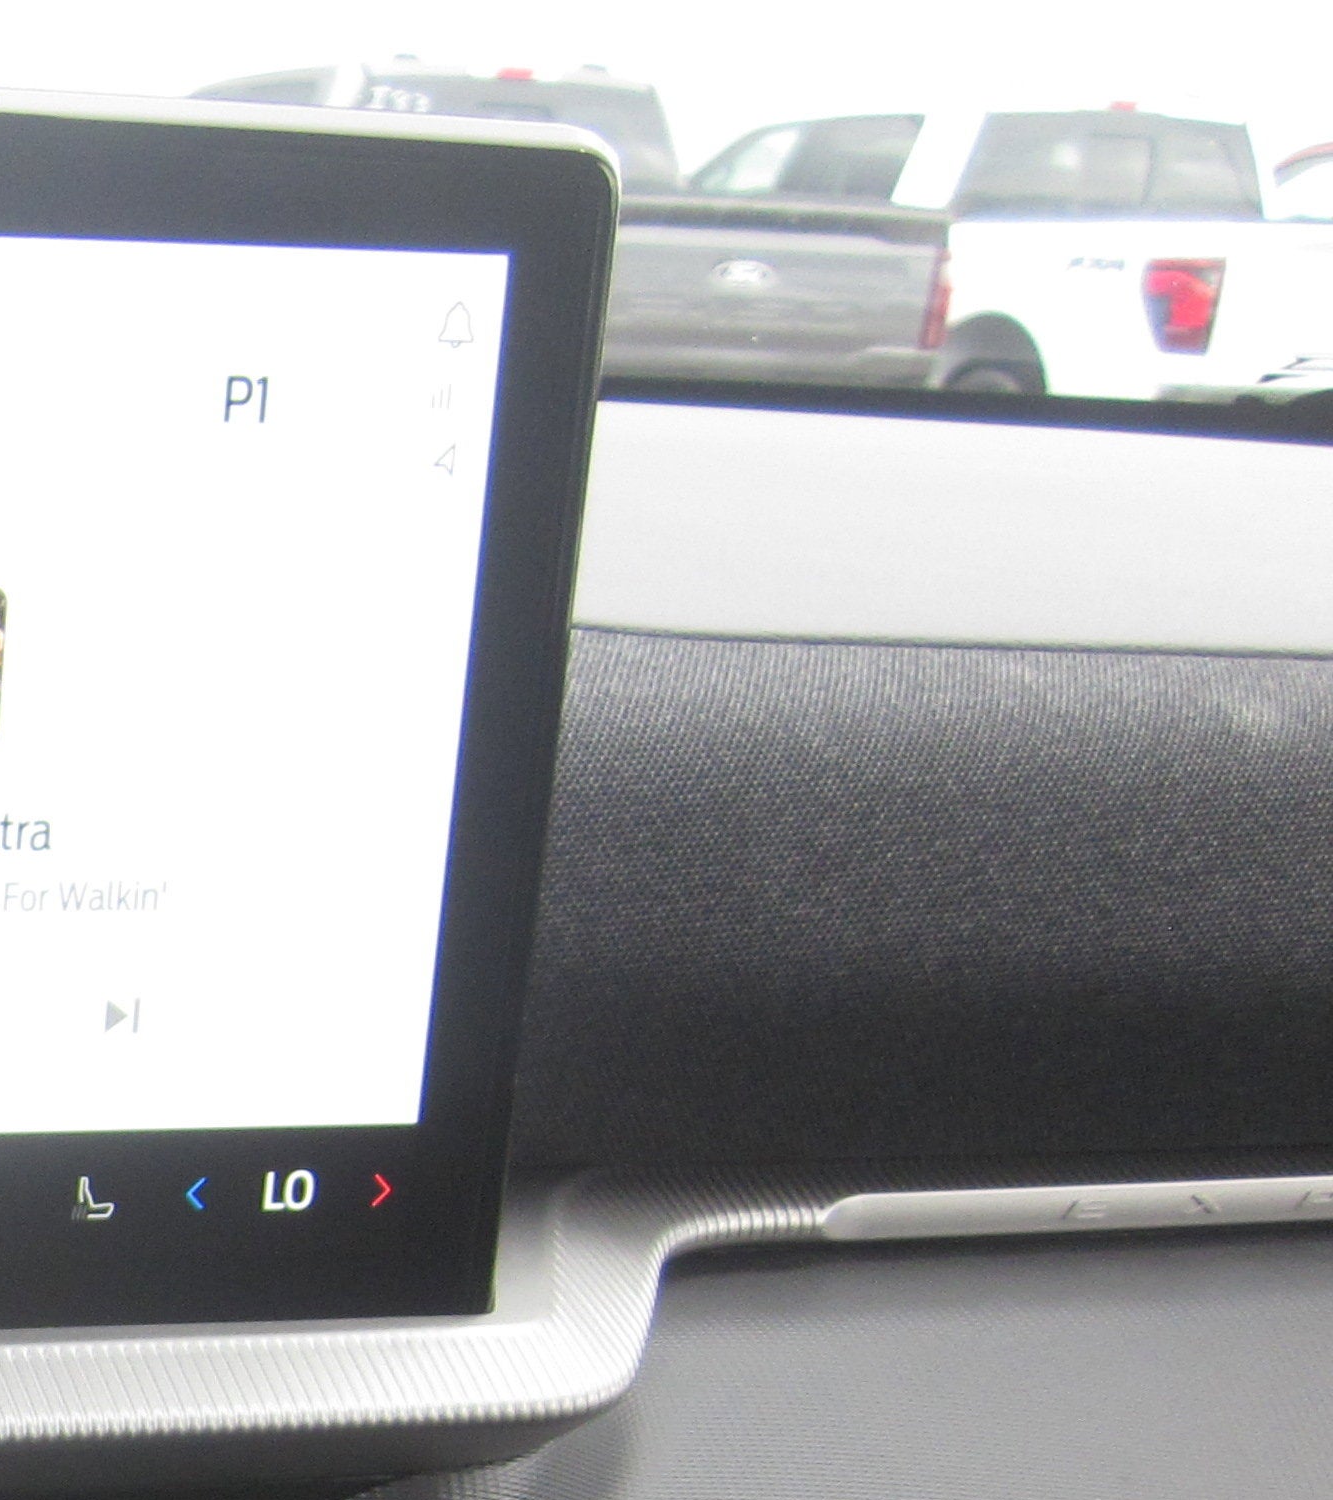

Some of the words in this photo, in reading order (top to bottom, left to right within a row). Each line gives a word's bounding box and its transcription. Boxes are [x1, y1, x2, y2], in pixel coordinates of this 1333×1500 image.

[222, 374, 271, 426] P1
[3, 881, 50, 914] For
[57, 879, 169, 912] Walkin'
[262, 1169, 317, 1213] LO
